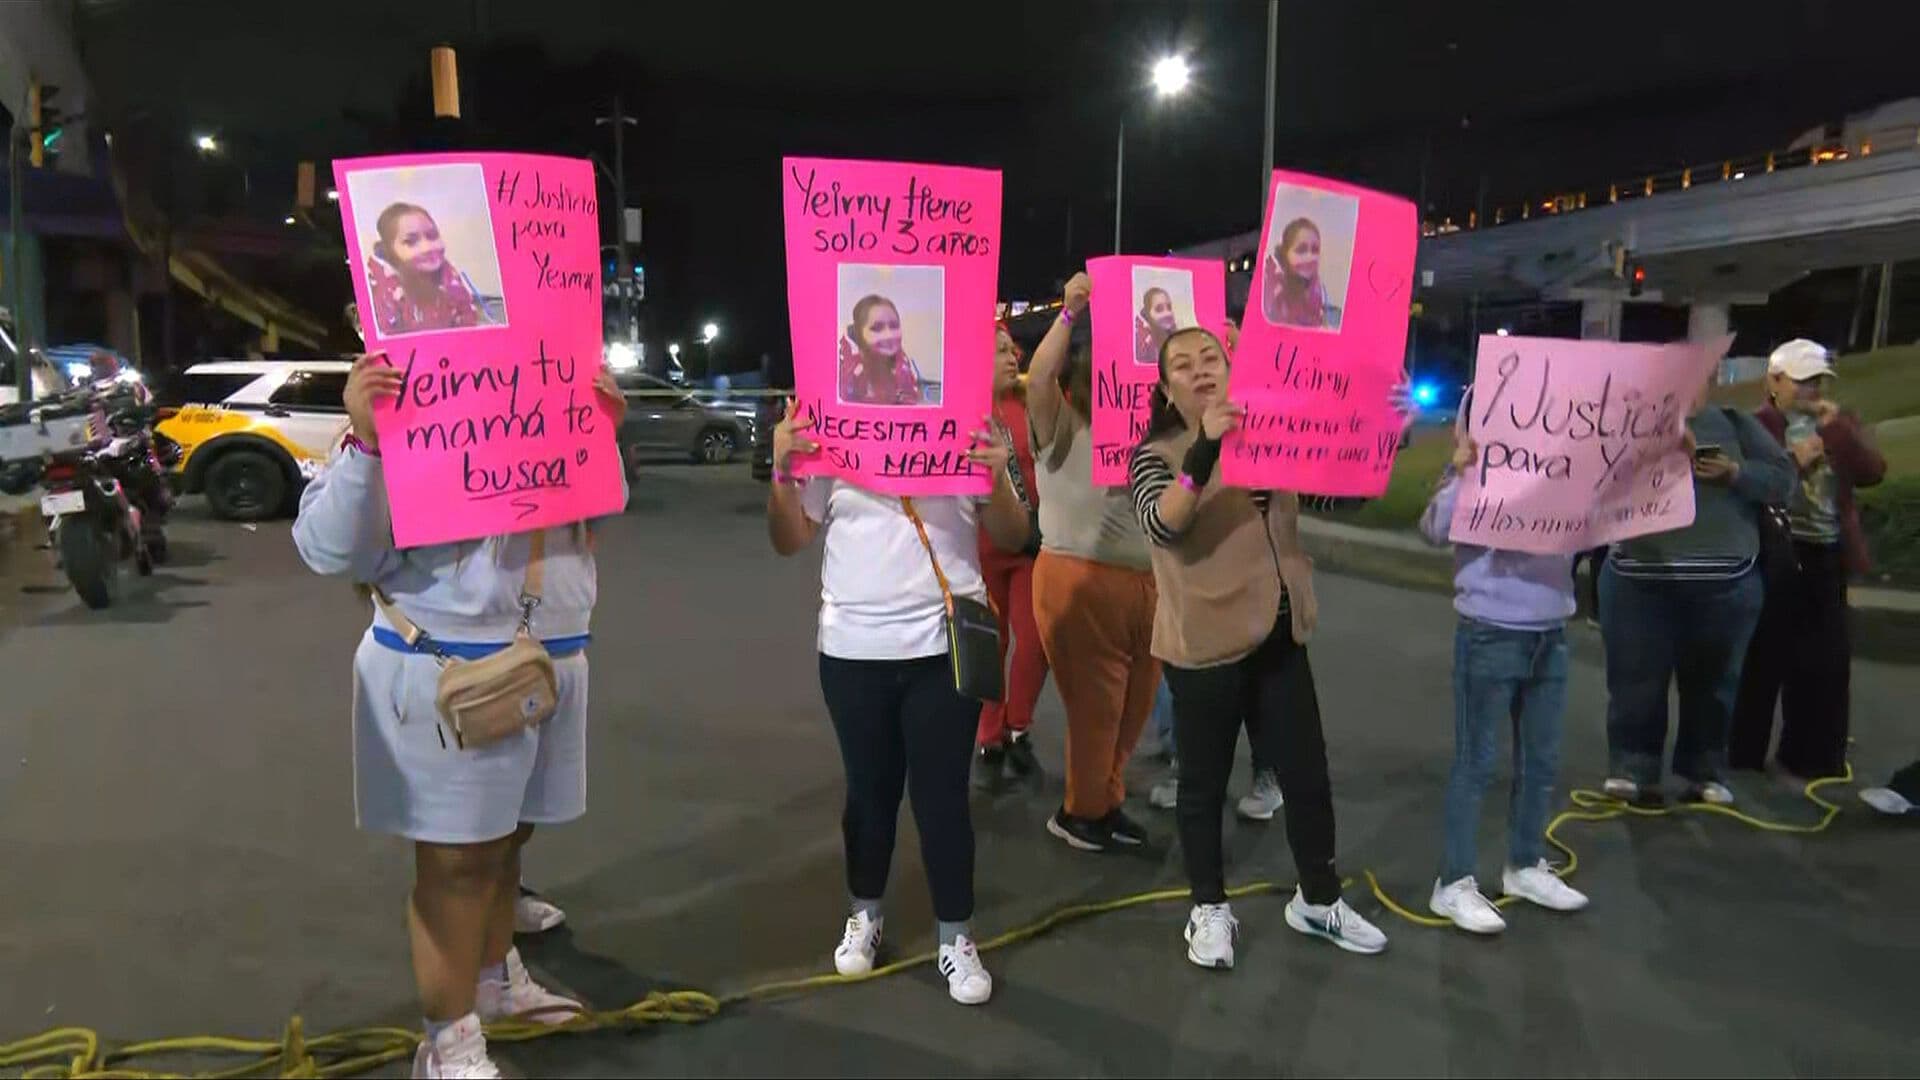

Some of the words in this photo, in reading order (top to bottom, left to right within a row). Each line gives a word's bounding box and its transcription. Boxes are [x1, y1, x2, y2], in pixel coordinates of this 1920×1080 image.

[792, 165, 891, 233] Yeimy
[903, 175, 973, 225] tiene
[511, 221, 566, 251] para
[814, 217, 878, 253] solo
[891, 219, 919, 255] 3
[926, 231, 990, 257] años
[531, 339, 576, 386] tu
[406, 399, 546, 451] mamá
[563, 388, 595, 434] te
[807, 398, 928, 443] NECESITA
[938, 419, 957, 440] A
[462, 451, 570, 493] busca
[827, 446, 860, 470] SU
[1480, 441, 1571, 488] para
